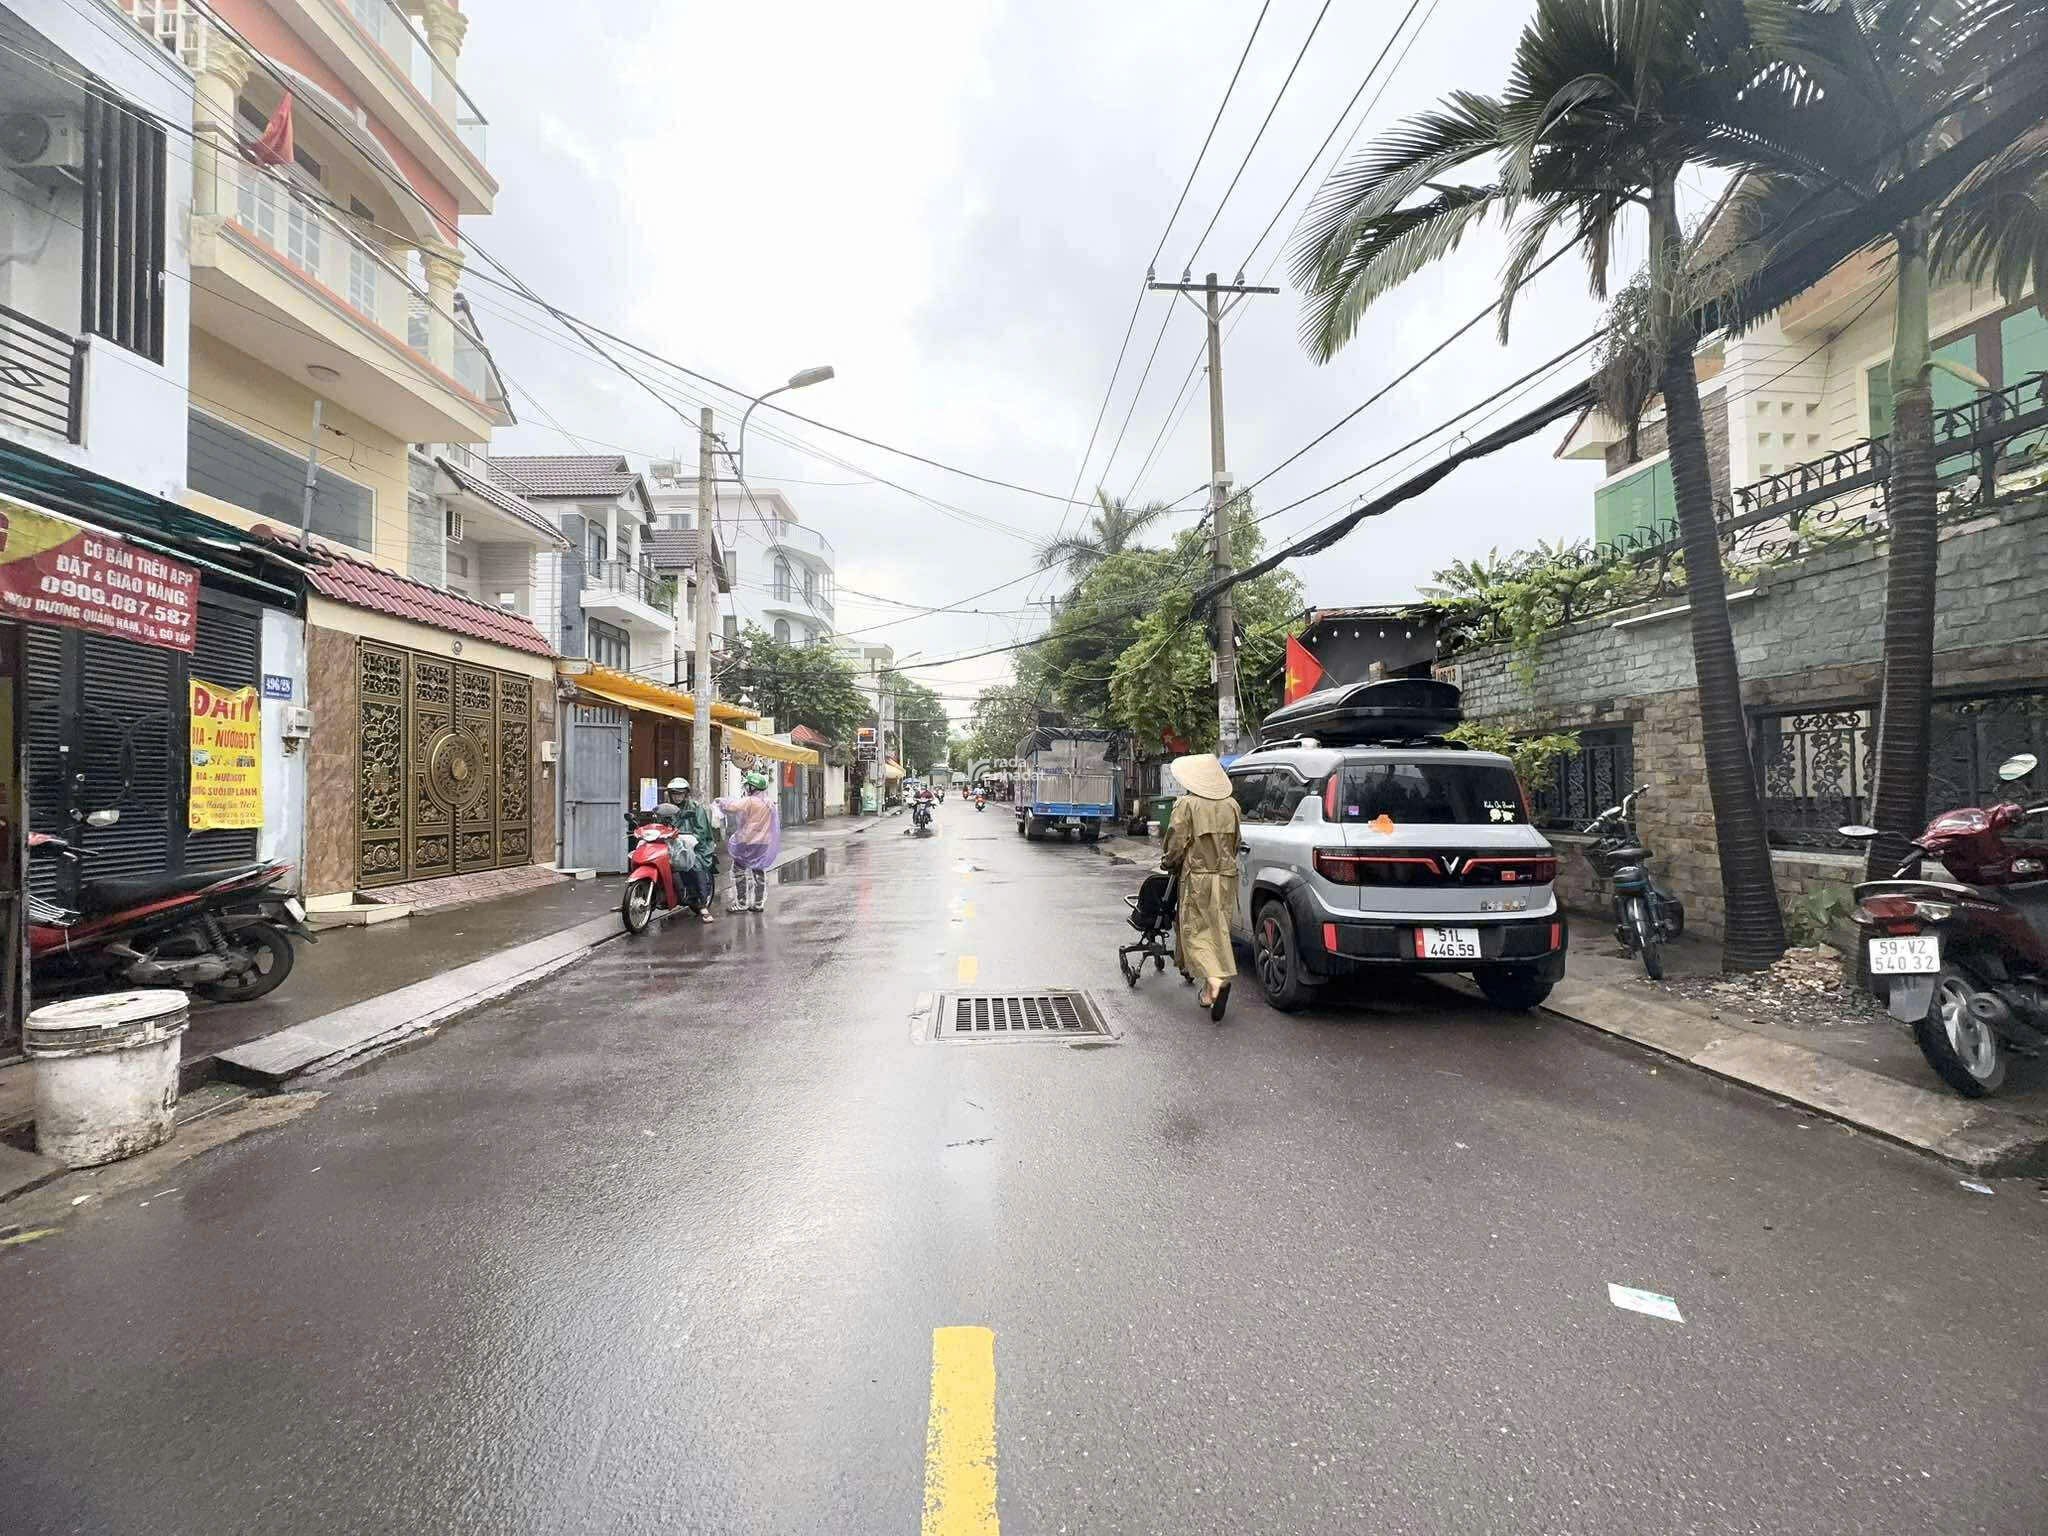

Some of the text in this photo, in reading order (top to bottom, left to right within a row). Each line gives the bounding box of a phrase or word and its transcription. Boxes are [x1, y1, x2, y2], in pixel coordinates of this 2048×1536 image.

[56, 554, 92, 579] ĐẶT
[93, 570, 103, 583] &
[106, 569, 143, 593] GIAO
[105, 547, 132, 569] BÁN
[137, 556, 168, 580] TRÊN
[40, 575, 191, 627] 0909.087.587
[1430, 944, 1475, 958] 446.59
[1438, 929, 1464, 943] 51L
